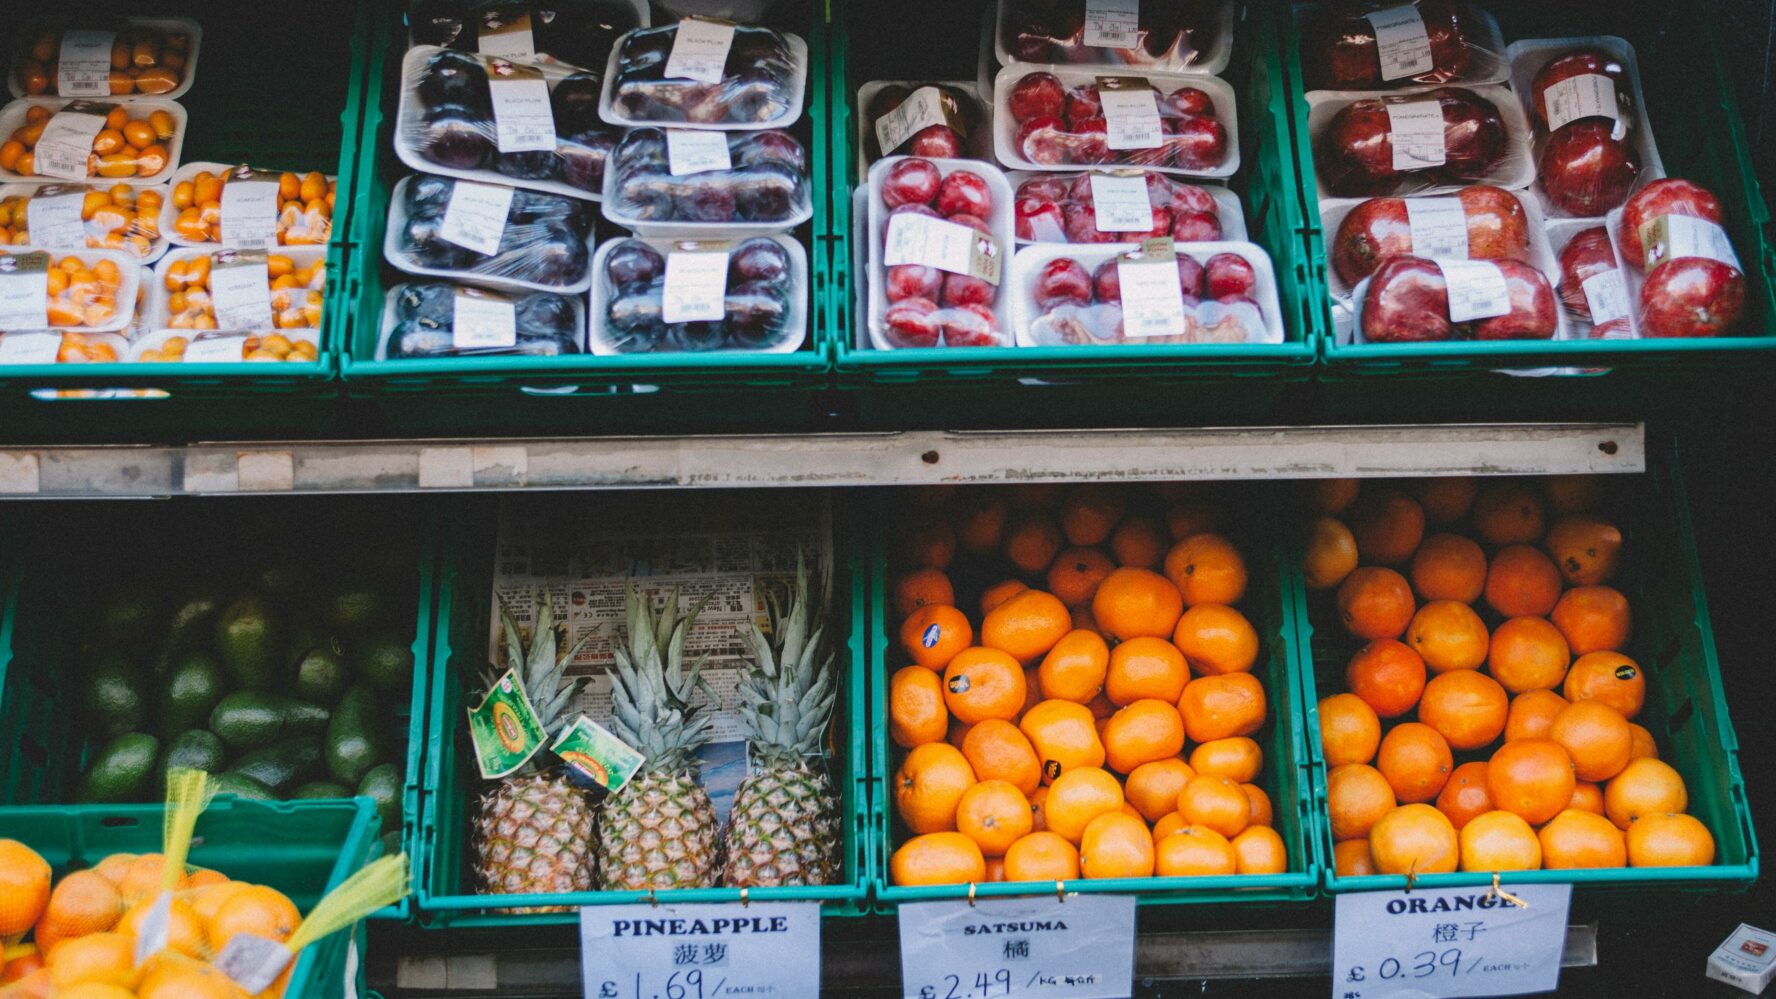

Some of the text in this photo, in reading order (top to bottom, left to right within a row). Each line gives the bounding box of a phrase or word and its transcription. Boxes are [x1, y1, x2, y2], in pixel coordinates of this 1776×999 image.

[1386, 893, 1517, 914] ORANGE
[613, 916, 788, 937] PINEAPPLE
[964, 921, 1068, 935] SATSUMA
[1432, 921, 1487, 943] 橙子
[674, 943, 729, 966] 菠萝
[1379, 948, 1462, 980] 0.39
[944, 969, 1011, 998] 2.49
